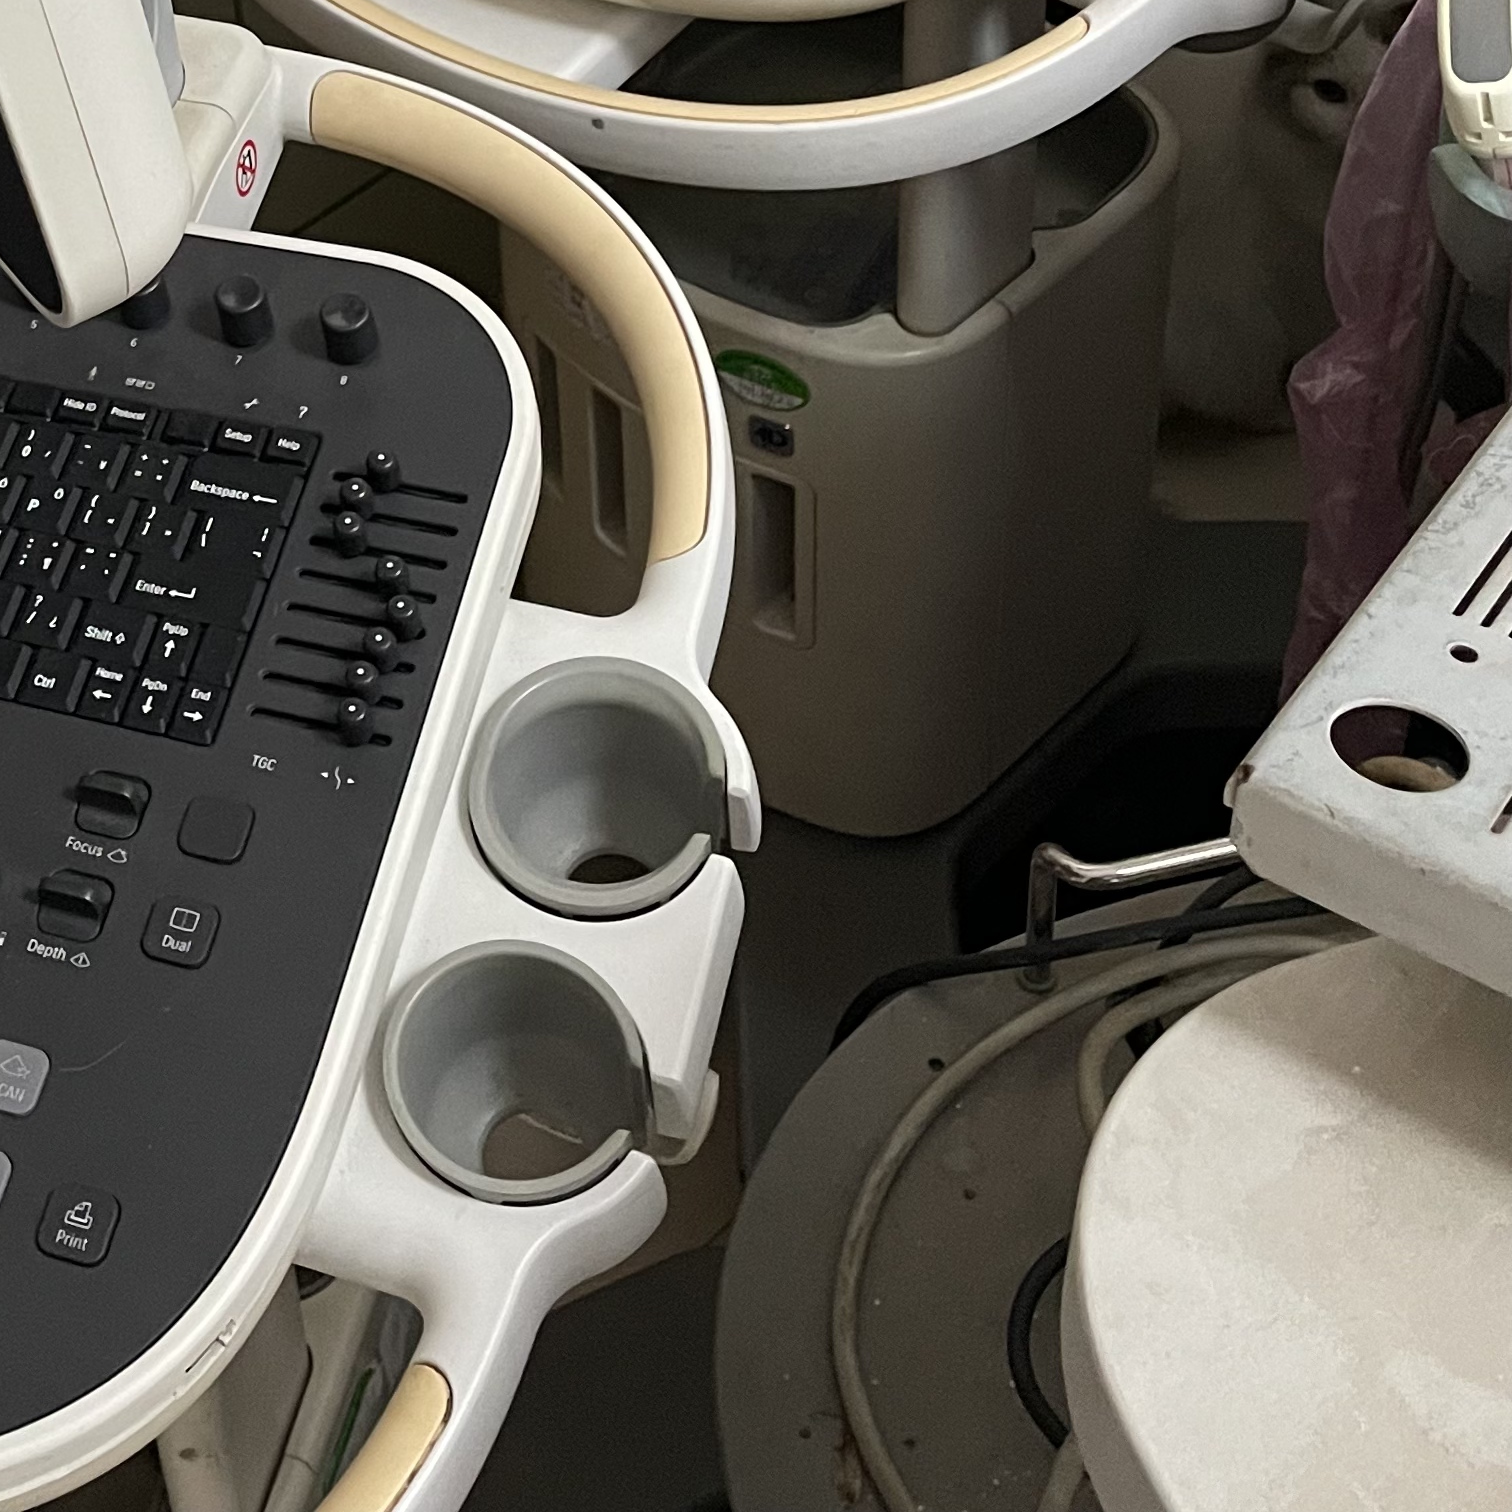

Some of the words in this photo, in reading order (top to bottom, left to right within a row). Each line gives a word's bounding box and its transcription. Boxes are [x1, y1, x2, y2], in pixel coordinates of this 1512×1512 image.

[190, 480, 249, 500] Backspace
[27, 499, 39, 511] P
[136, 580, 166, 595] Enter
[85, 626, 112, 641] Shift
[163, 622, 188, 636] PgUp
[34, 674, 55, 688] Ctrl
[96, 667, 123, 681] Home
[191, 689, 211, 701] End
[253, 755, 276, 771] TGC
[66, 836, 103, 856] Focus
[27, 939, 66, 960] Depth
[162, 935, 191, 952] Dual
[56, 1227, 90, 1251] Print
